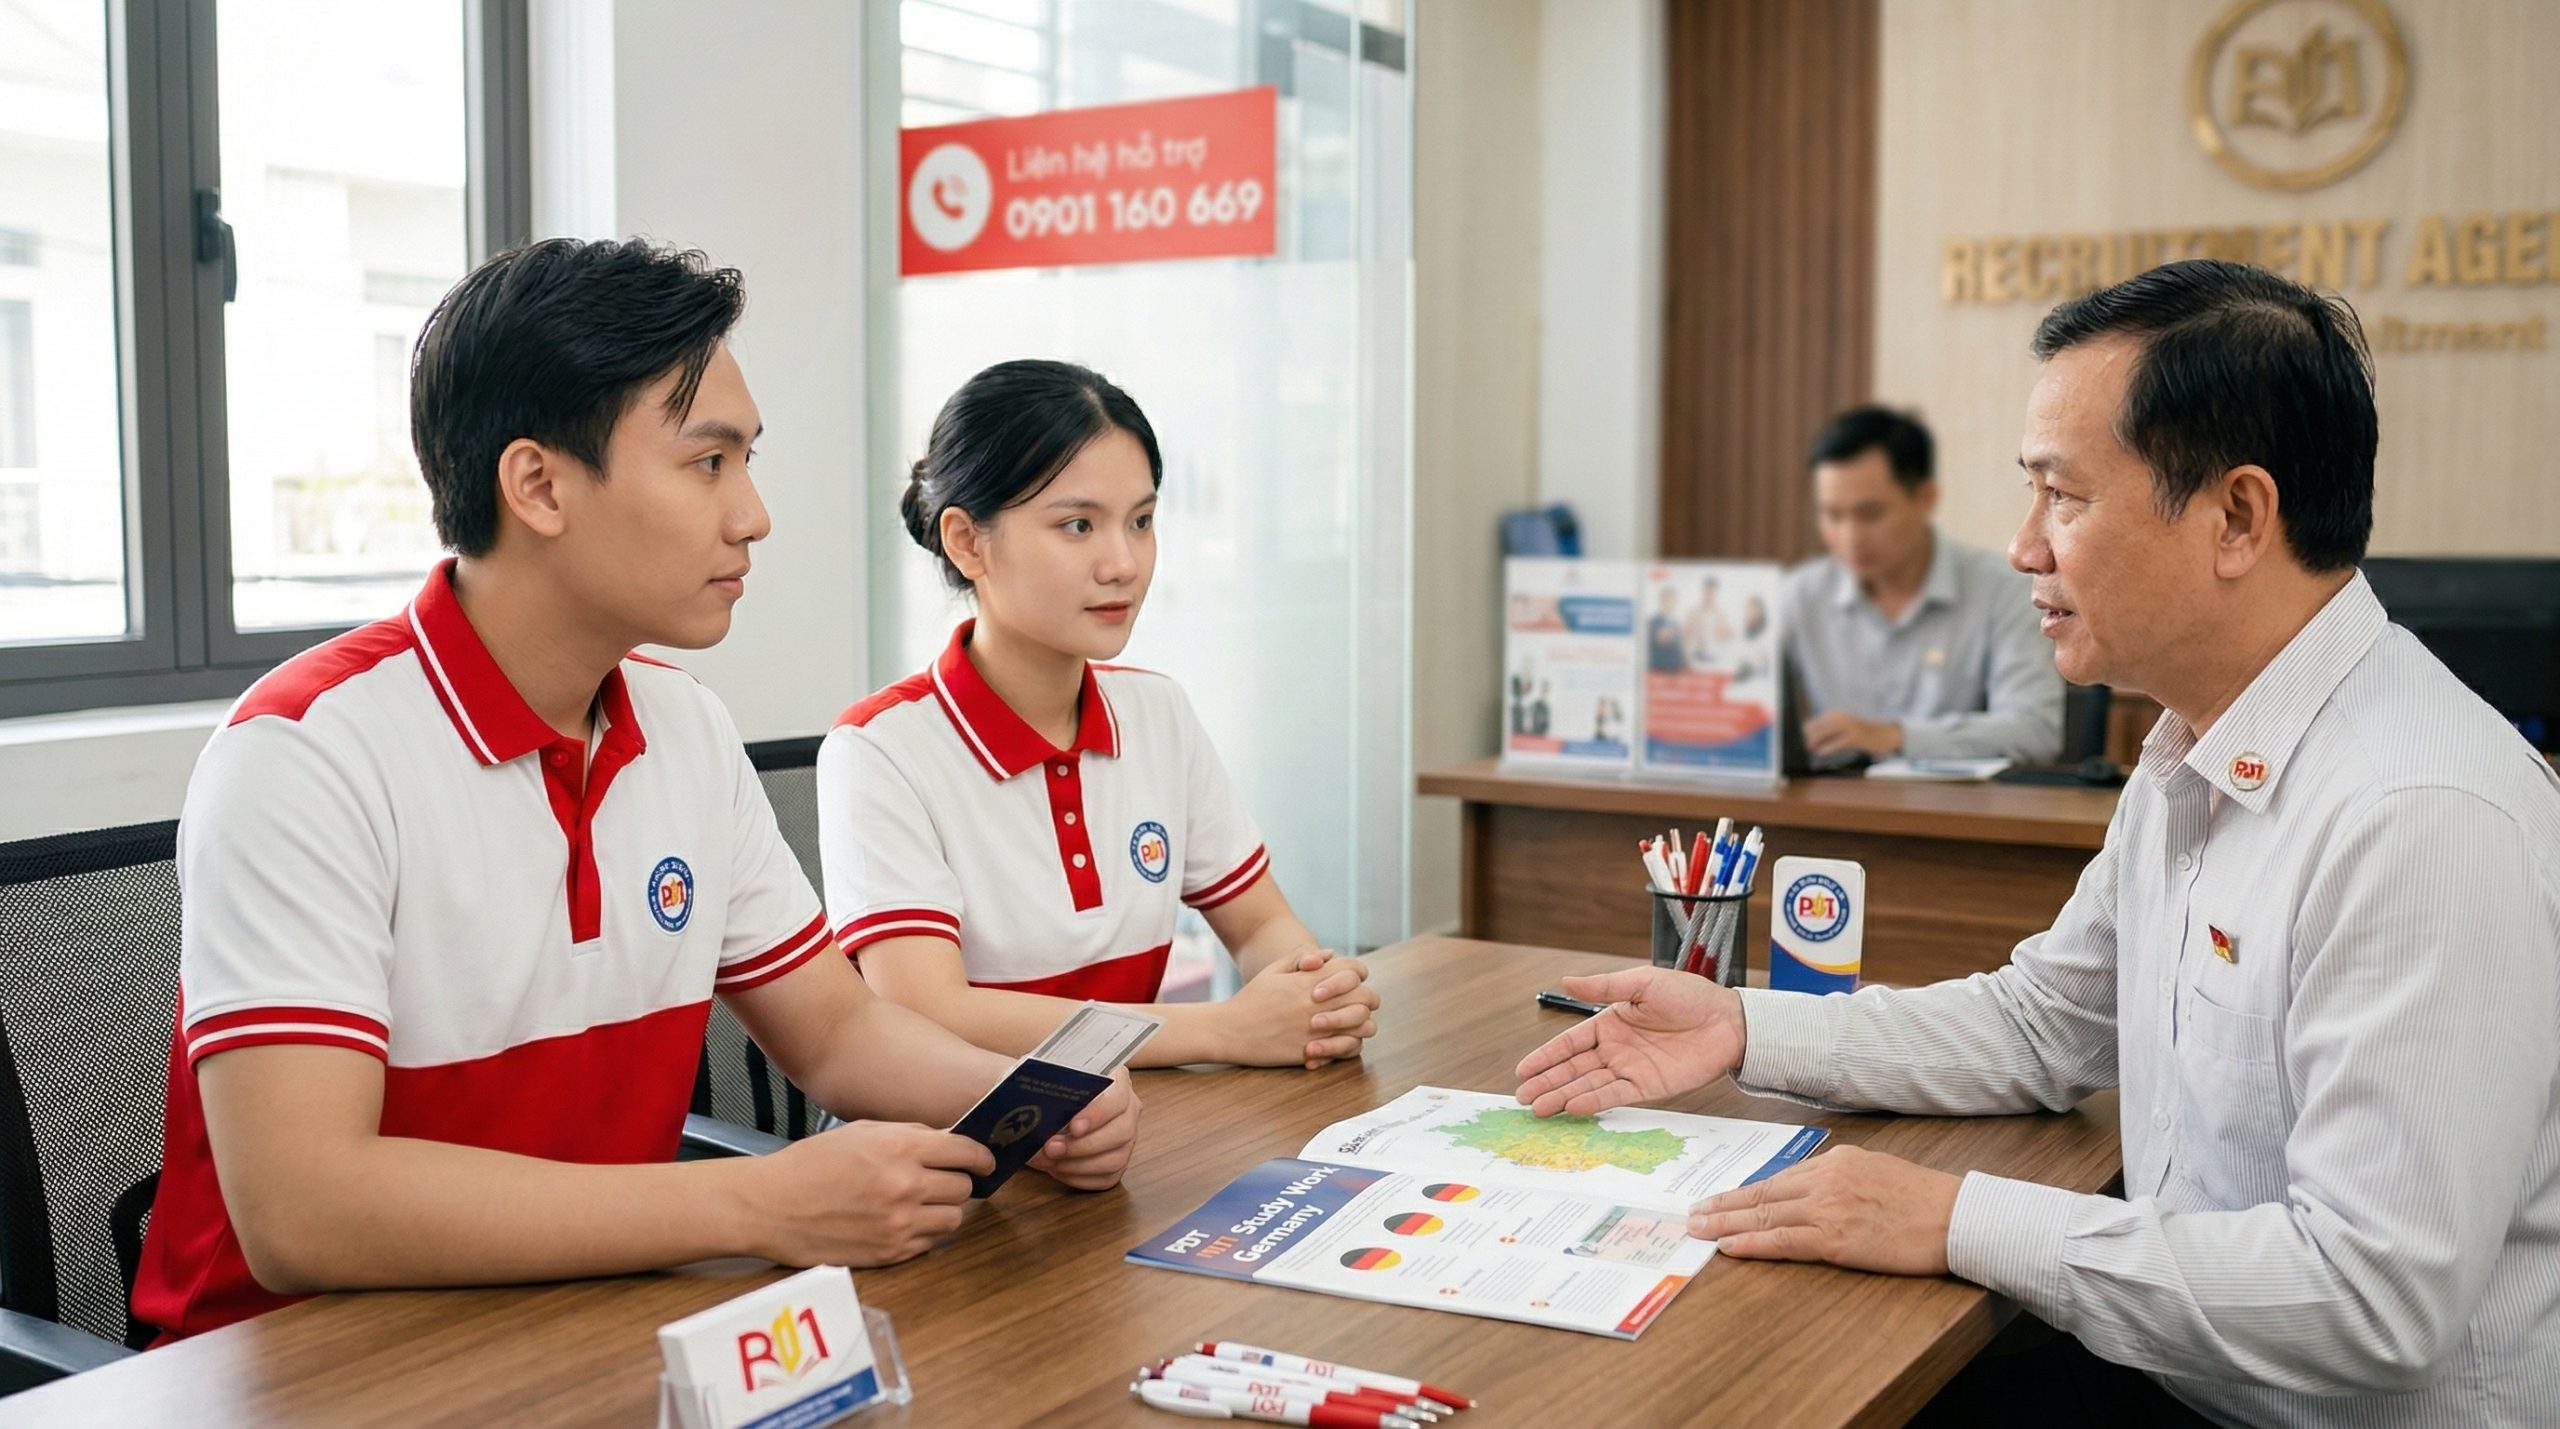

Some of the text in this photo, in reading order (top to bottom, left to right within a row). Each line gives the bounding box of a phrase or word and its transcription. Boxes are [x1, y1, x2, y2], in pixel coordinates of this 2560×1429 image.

[1007, 147, 1067, 182] Liên
[1073, 141, 1109, 180] hệ
[1163, 136, 1208, 173] trợ
[1005, 179, 1263, 240] 0901 160 669
[1230, 1197, 1294, 1235] Study
[1280, 1165, 1341, 1195] Work
[1165, 1230, 1210, 1254] PDT
[1233, 1204, 1324, 1262] Germany
